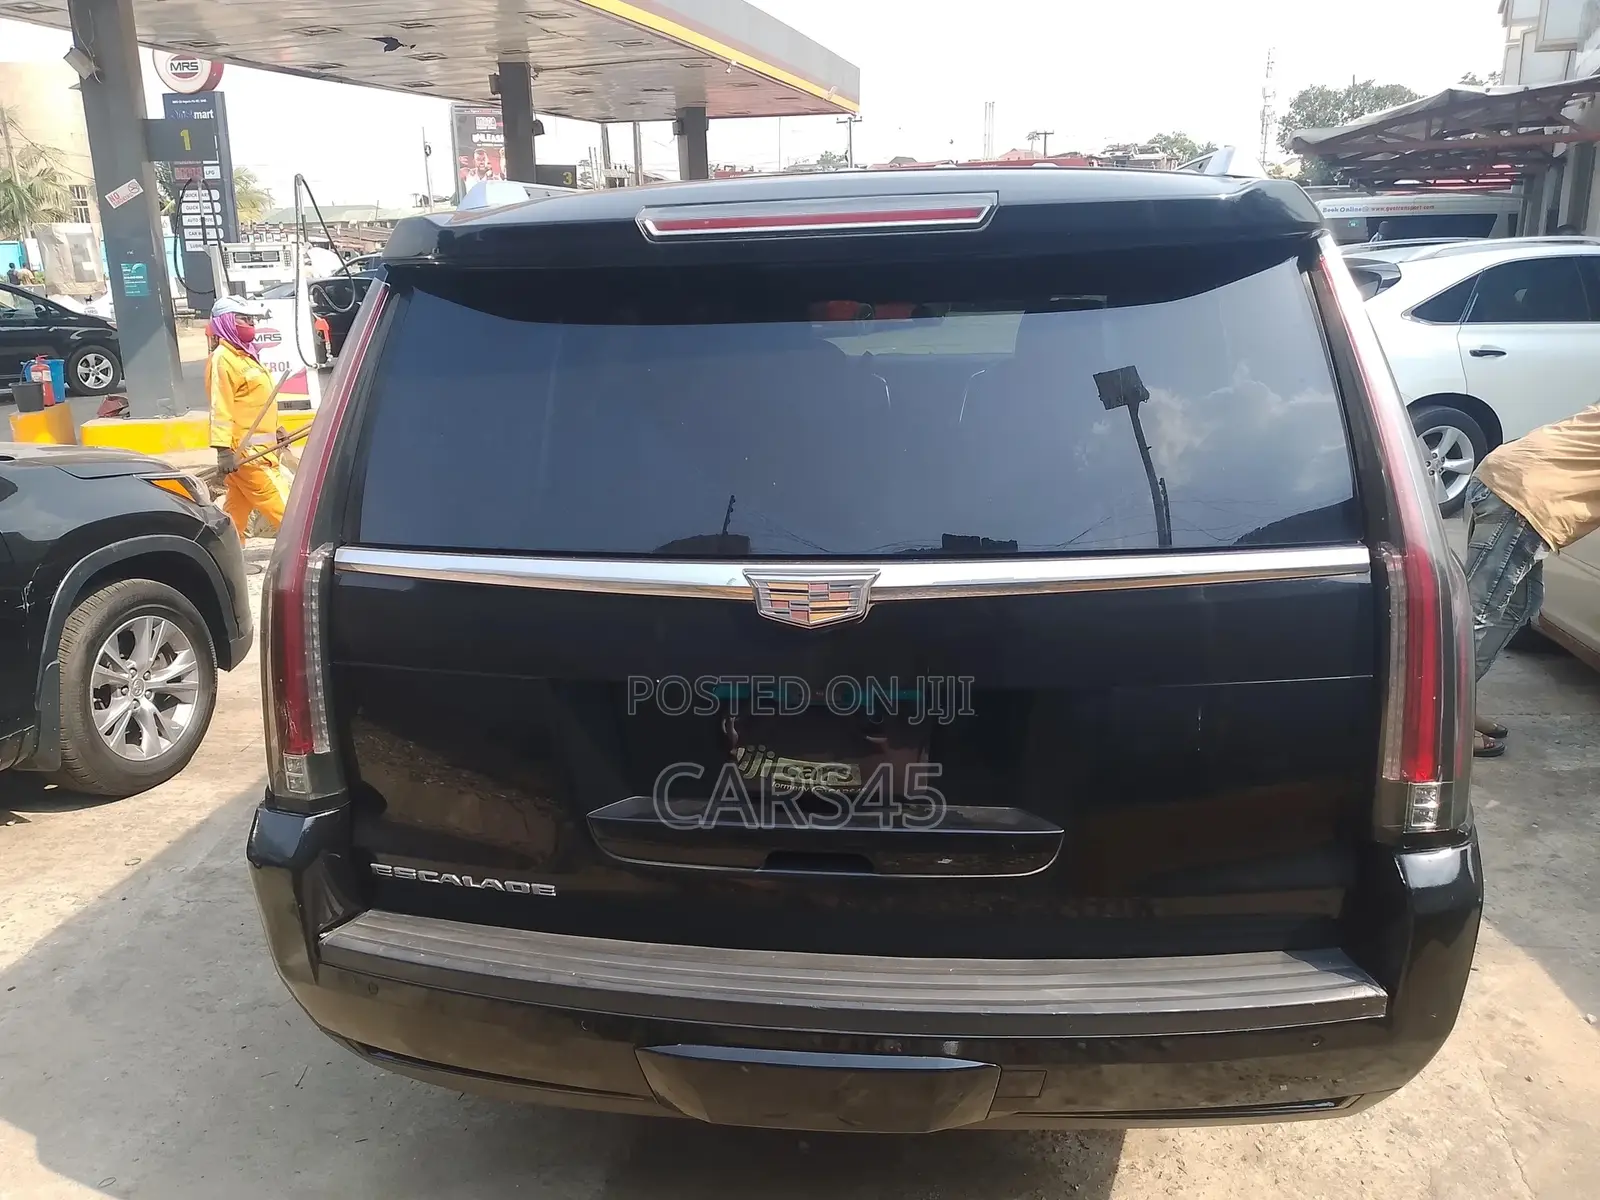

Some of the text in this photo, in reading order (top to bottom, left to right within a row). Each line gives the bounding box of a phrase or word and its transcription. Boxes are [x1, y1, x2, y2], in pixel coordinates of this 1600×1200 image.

[170, 61, 199, 71] MRS
[180, 129, 191, 151] 1
[562, 171, 573, 185] 3
[369, 863, 557, 897] ESCALADE
